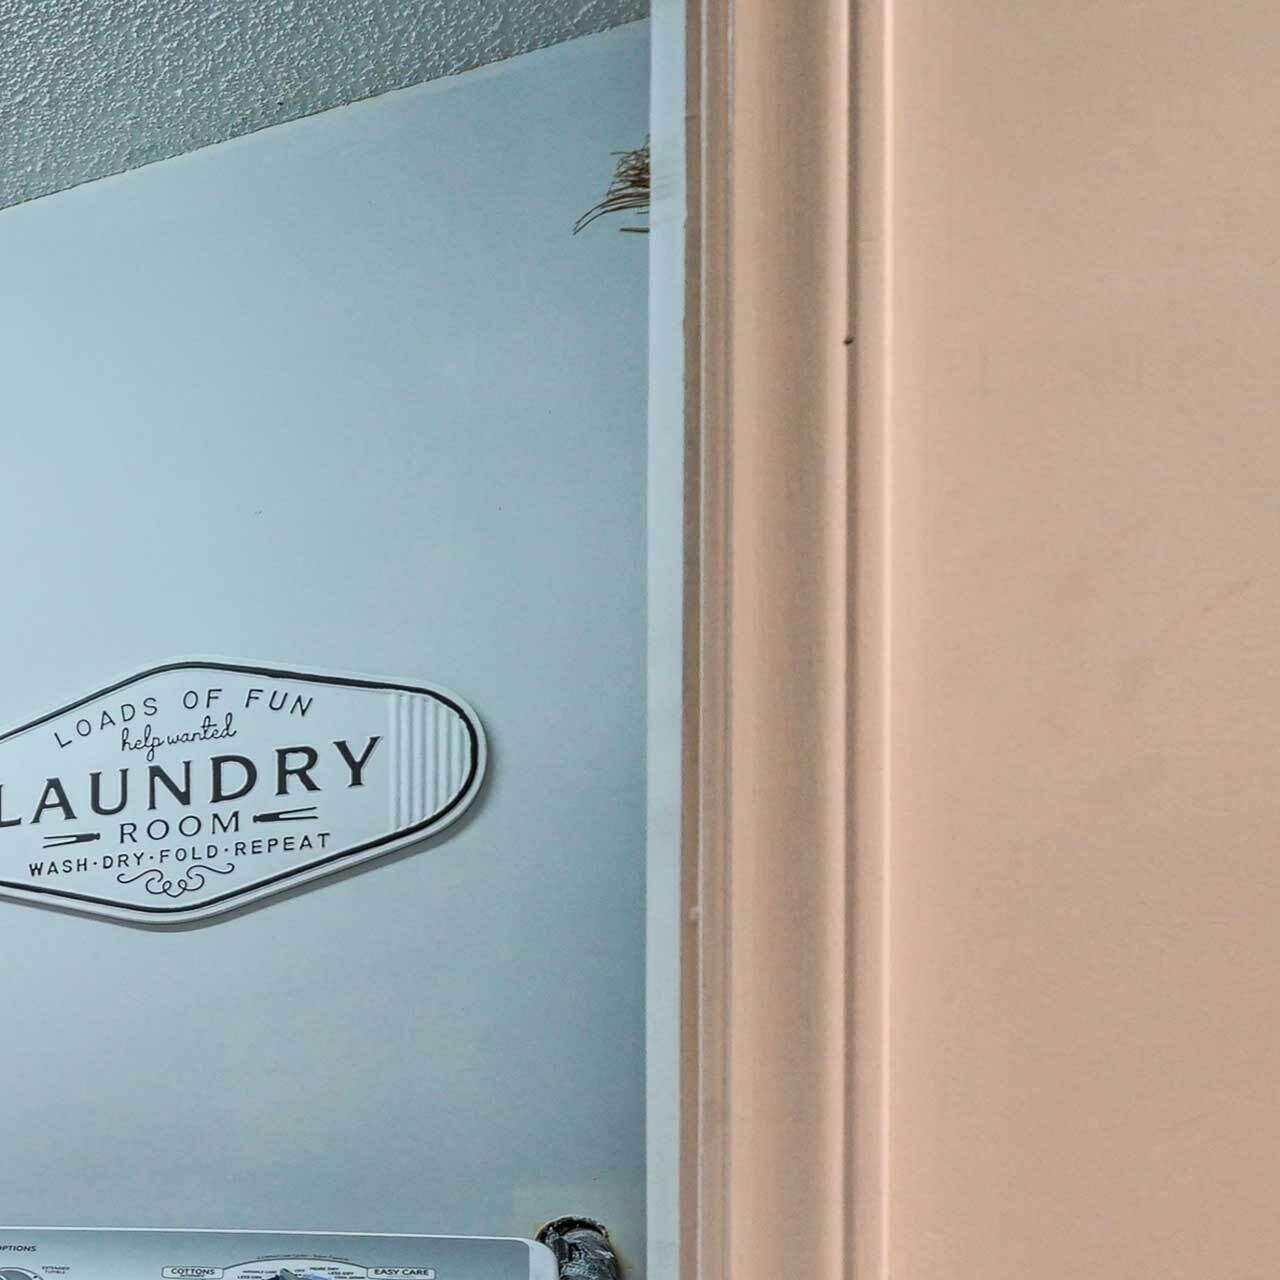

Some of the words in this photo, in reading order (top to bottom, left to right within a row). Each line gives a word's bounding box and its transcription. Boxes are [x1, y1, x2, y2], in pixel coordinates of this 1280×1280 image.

[53, 697, 158, 748] LOADS
[183, 688, 222, 709] OF
[245, 688, 313, 717] FUN
[120, 724, 164, 762] help
[166, 712, 237, 744] wanted
[120, 811, 240, 844] ROOM
[171, 1267, 216, 1275] COTTONS
[374, 1268, 400, 1276] EASY
[401, 1268, 430, 1276] CARE
